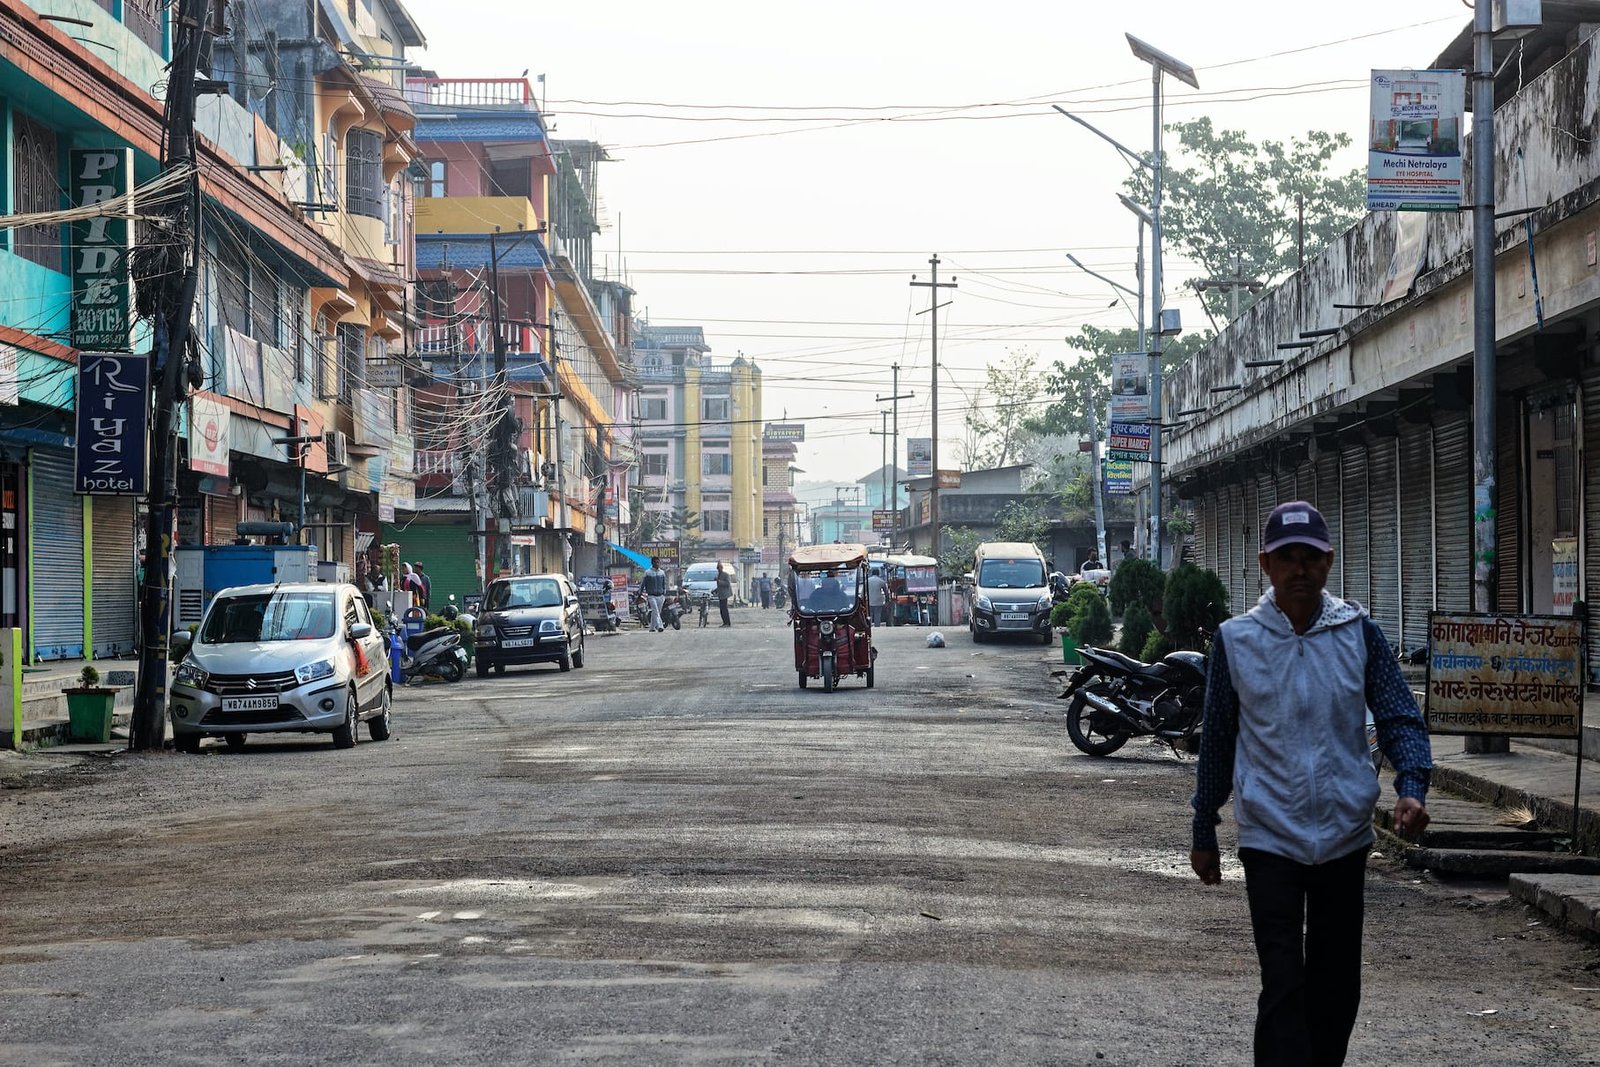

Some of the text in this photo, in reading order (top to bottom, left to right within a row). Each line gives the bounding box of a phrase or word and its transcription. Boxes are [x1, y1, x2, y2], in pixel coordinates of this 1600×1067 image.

[1383, 159, 1448, 173] Mechi Netralaya
[77, 153, 119, 305] PRIDE
[77, 308, 124, 332] HOTEL
[83, 357, 141, 474] Riyaz
[1111, 436, 1149, 450] SUPER MARKET
[84, 477, 133, 490] hotel
[659, 547, 678, 558] HOTEL
[228, 698, 277, 710] WB74AM9856
